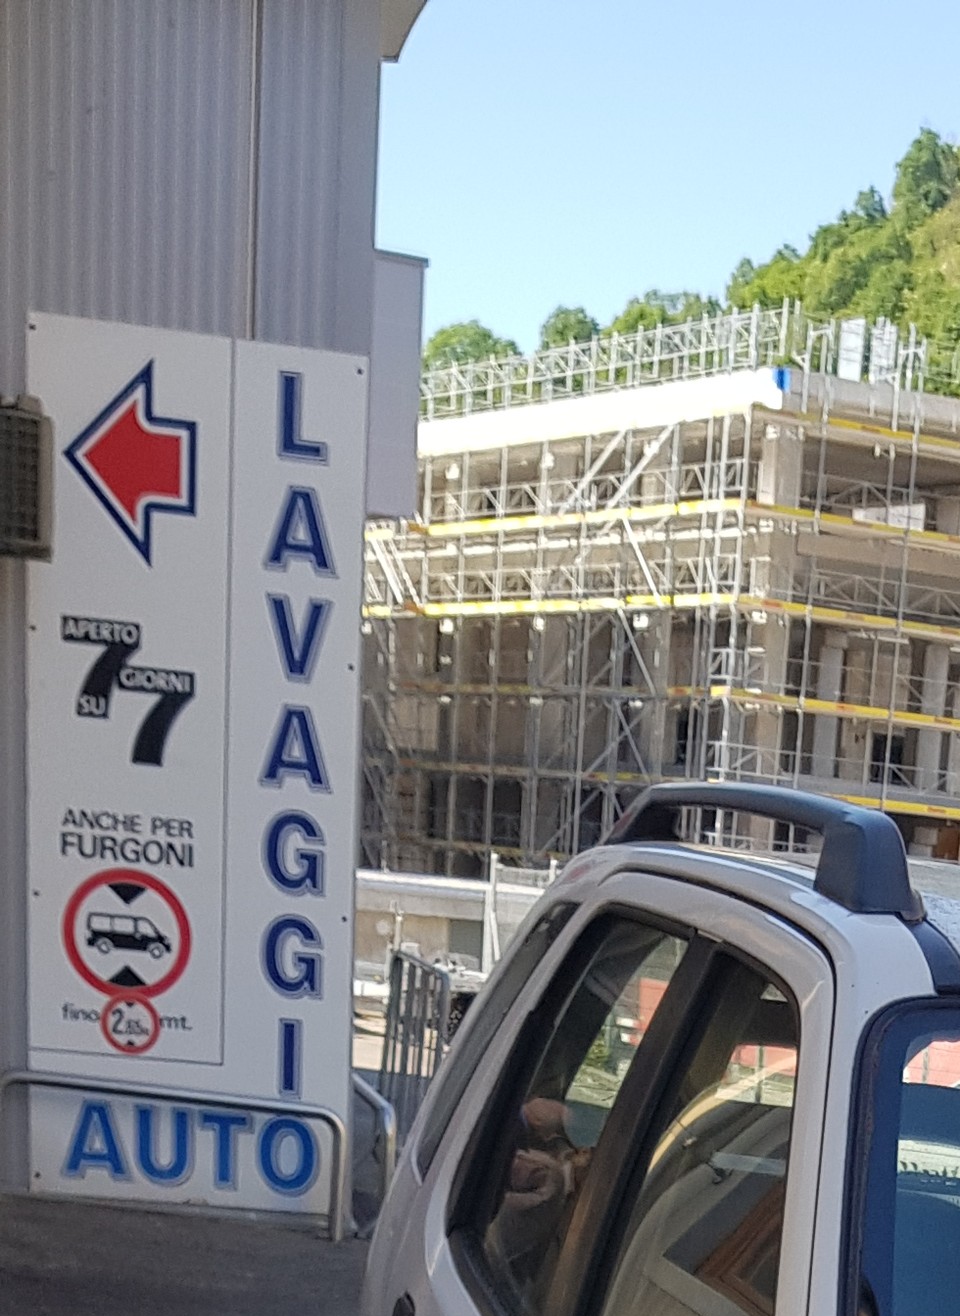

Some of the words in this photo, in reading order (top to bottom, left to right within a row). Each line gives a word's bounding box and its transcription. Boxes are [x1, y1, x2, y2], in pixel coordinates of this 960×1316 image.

[63, 617, 139, 645] APERTO
[118, 667, 191, 694] GIORNI
[78, 694, 106, 716] SU
[258, 370, 339, 1098] LAVAGGI
[61, 808, 142, 834] ANCHE
[150, 816, 195, 839] PER
[61, 831, 195, 868] FURGONI
[62, 1001, 100, 1023] fino
[62, 1099, 321, 1198] AUTO
